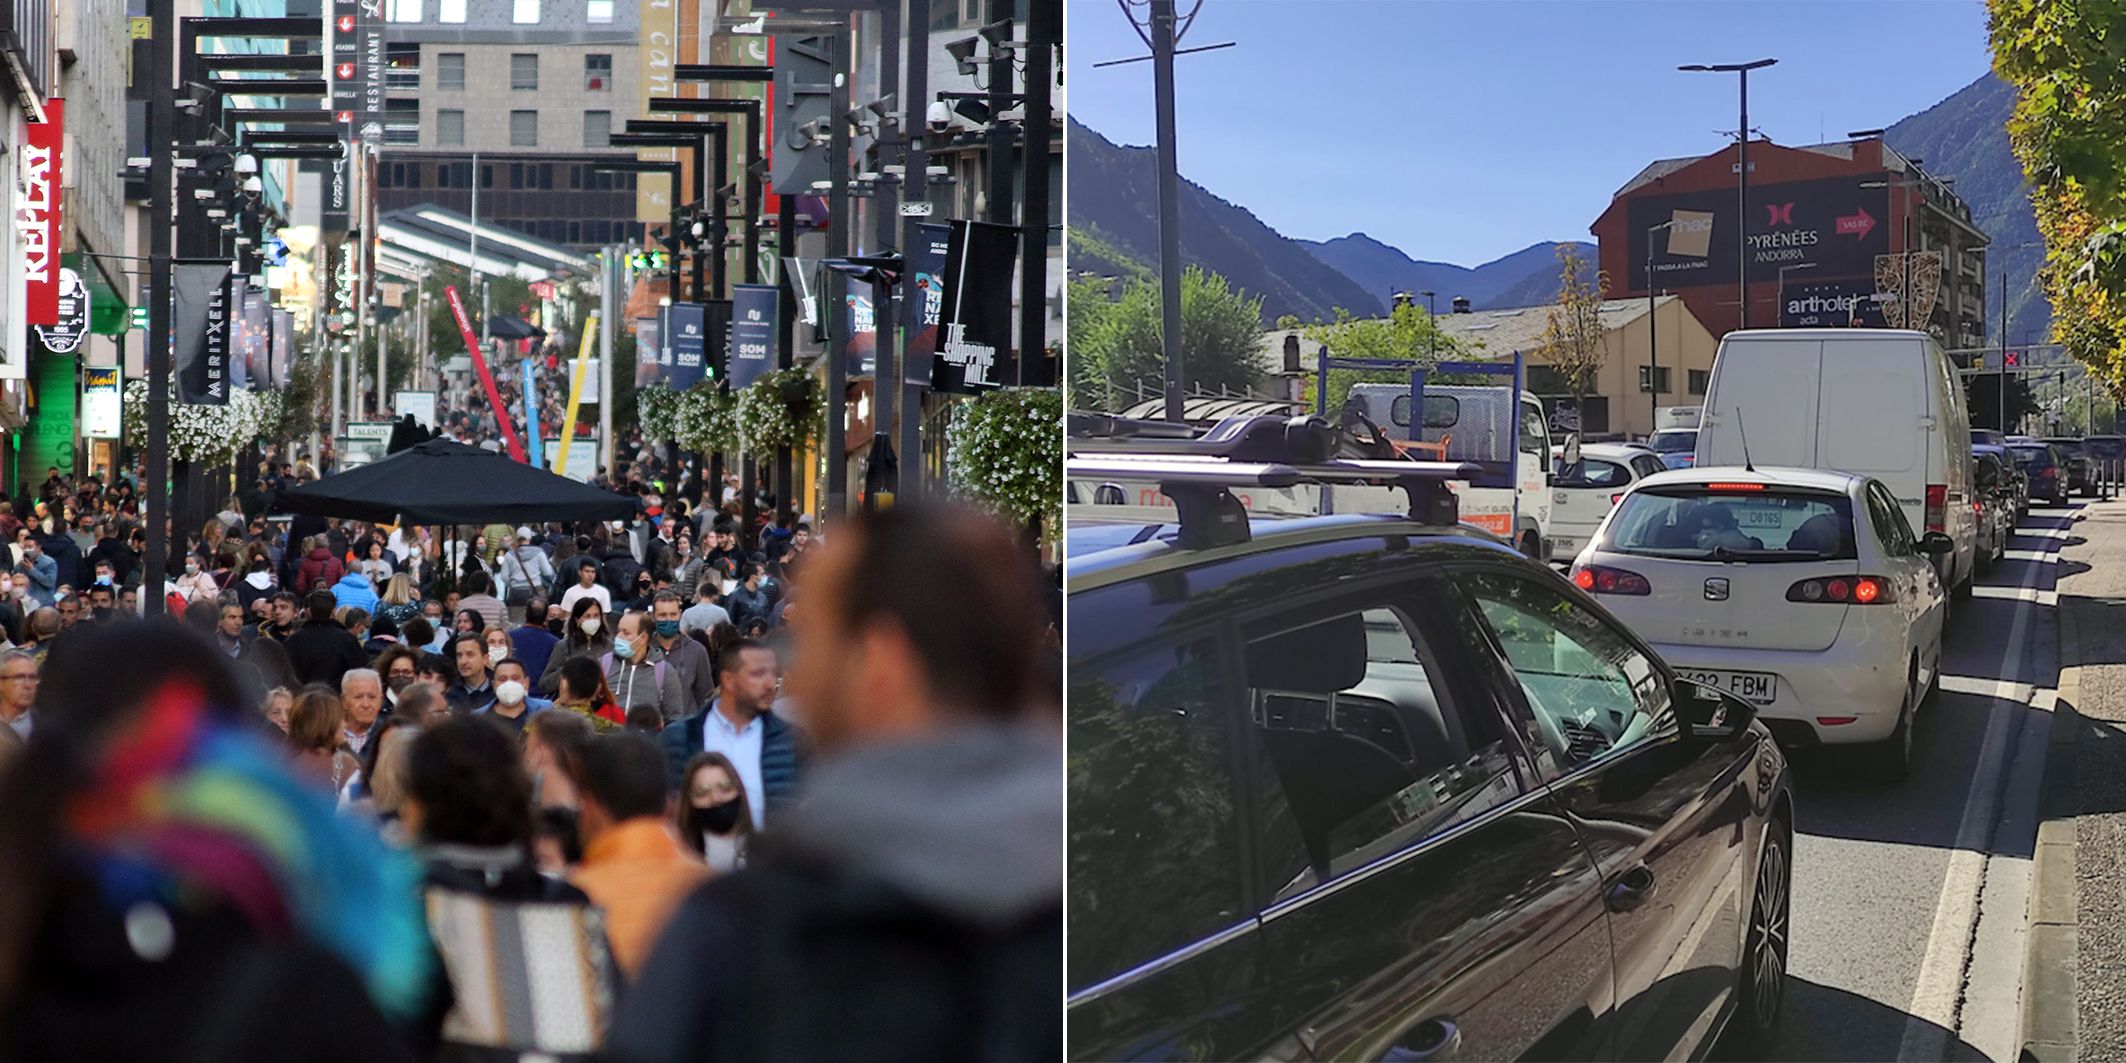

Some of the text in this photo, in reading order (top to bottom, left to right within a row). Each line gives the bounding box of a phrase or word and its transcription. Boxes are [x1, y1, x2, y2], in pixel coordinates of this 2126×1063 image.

[367, 32, 380, 112] RESTAURANT
[649, 31, 669, 95] can
[16, 144, 50, 284] REPLAY
[1755, 249, 1805, 263] ANDORRA
[1788, 292, 1857, 314] arthotel
[206, 288, 225, 398] MERITXELL
[947, 323, 966, 344] THE
[678, 353, 700, 362] SOM
[740, 344, 766, 354] SOM
[943, 342, 996, 366] SHOPPING
[964, 363, 990, 383] MILE
[1730, 675, 1768, 697] FBM
